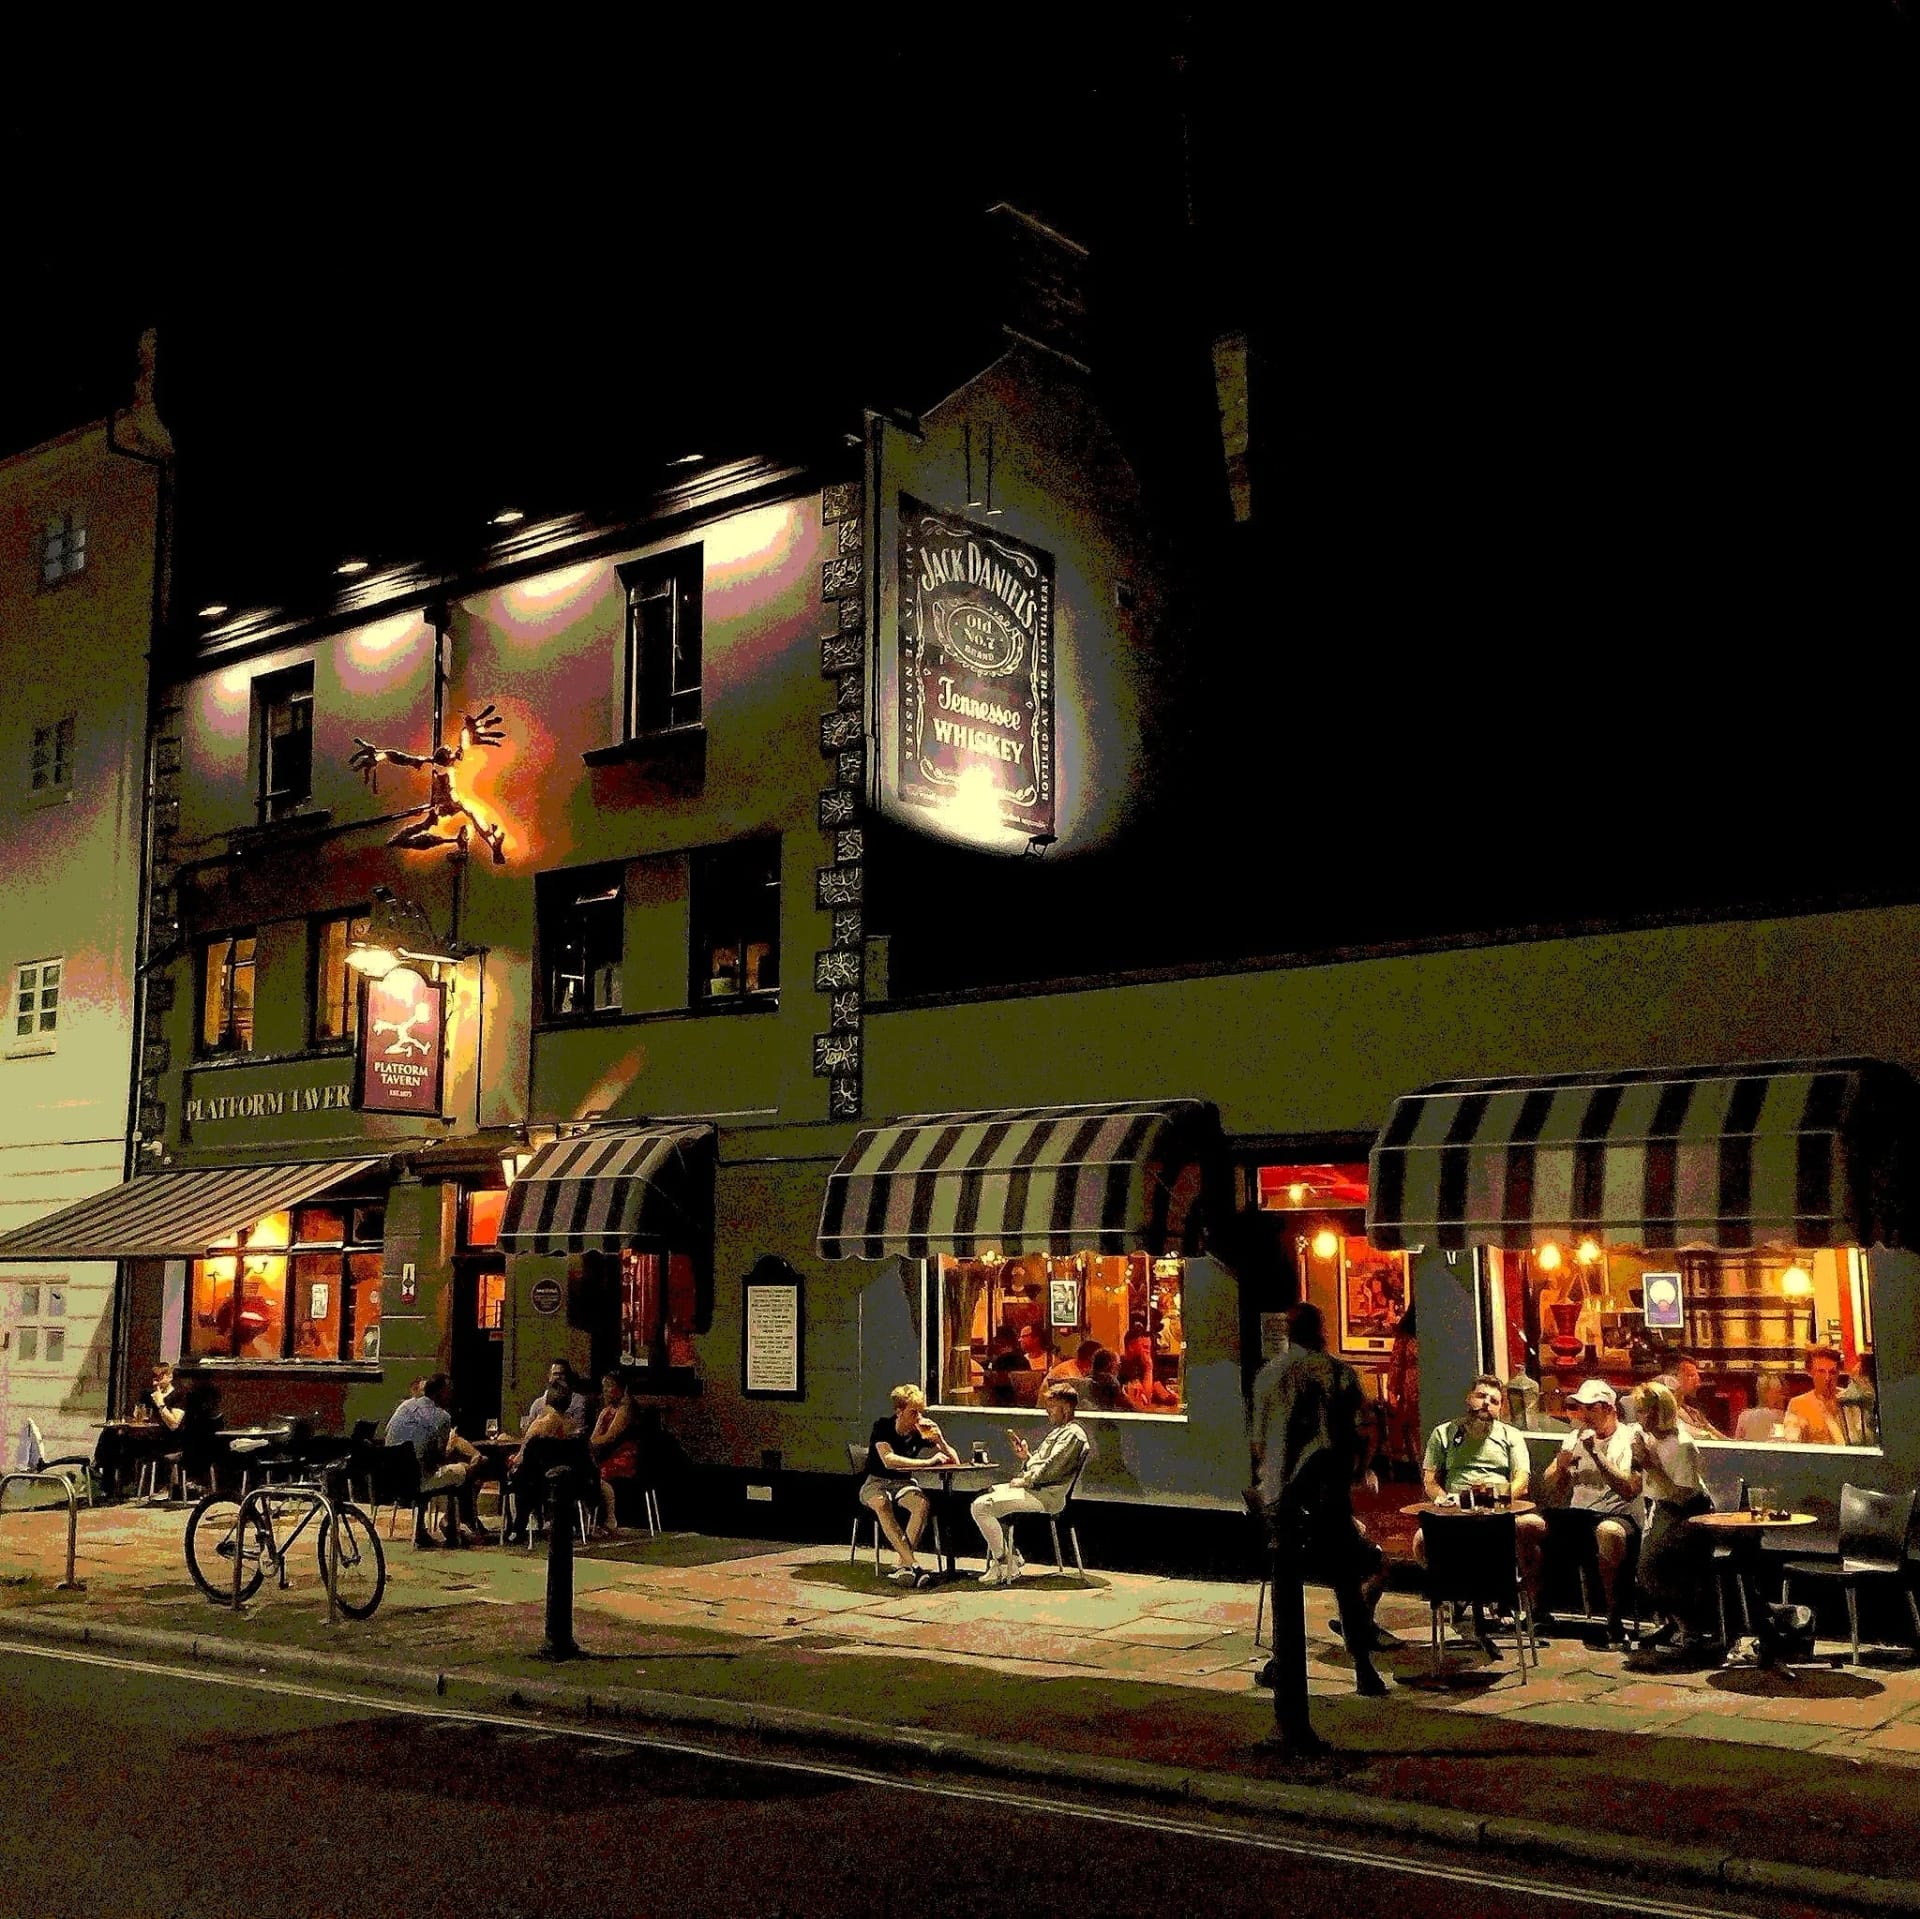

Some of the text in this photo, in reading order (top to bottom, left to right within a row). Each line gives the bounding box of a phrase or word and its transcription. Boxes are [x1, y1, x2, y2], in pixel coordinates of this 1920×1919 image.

[920, 547, 966, 592] JACK
[967, 541, 1038, 629] DANIEL'S
[966, 614, 992, 634] Old
[1040, 575, 1049, 664] DISTILLERY
[964, 645, 995, 661] BRAND
[905, 634, 914, 761] TENNESSEE
[938, 676, 1021, 731] Tennessee
[1040, 669, 1049, 700] THE
[932, 716, 1024, 764] WHISKEY
[1040, 732, 1050, 801] BOTTLED
[374, 1061, 429, 1077] PLATFORM
[380, 1073, 421, 1087] TAVERN
[186, 1084, 351, 1121] PLATFORM TAVER
